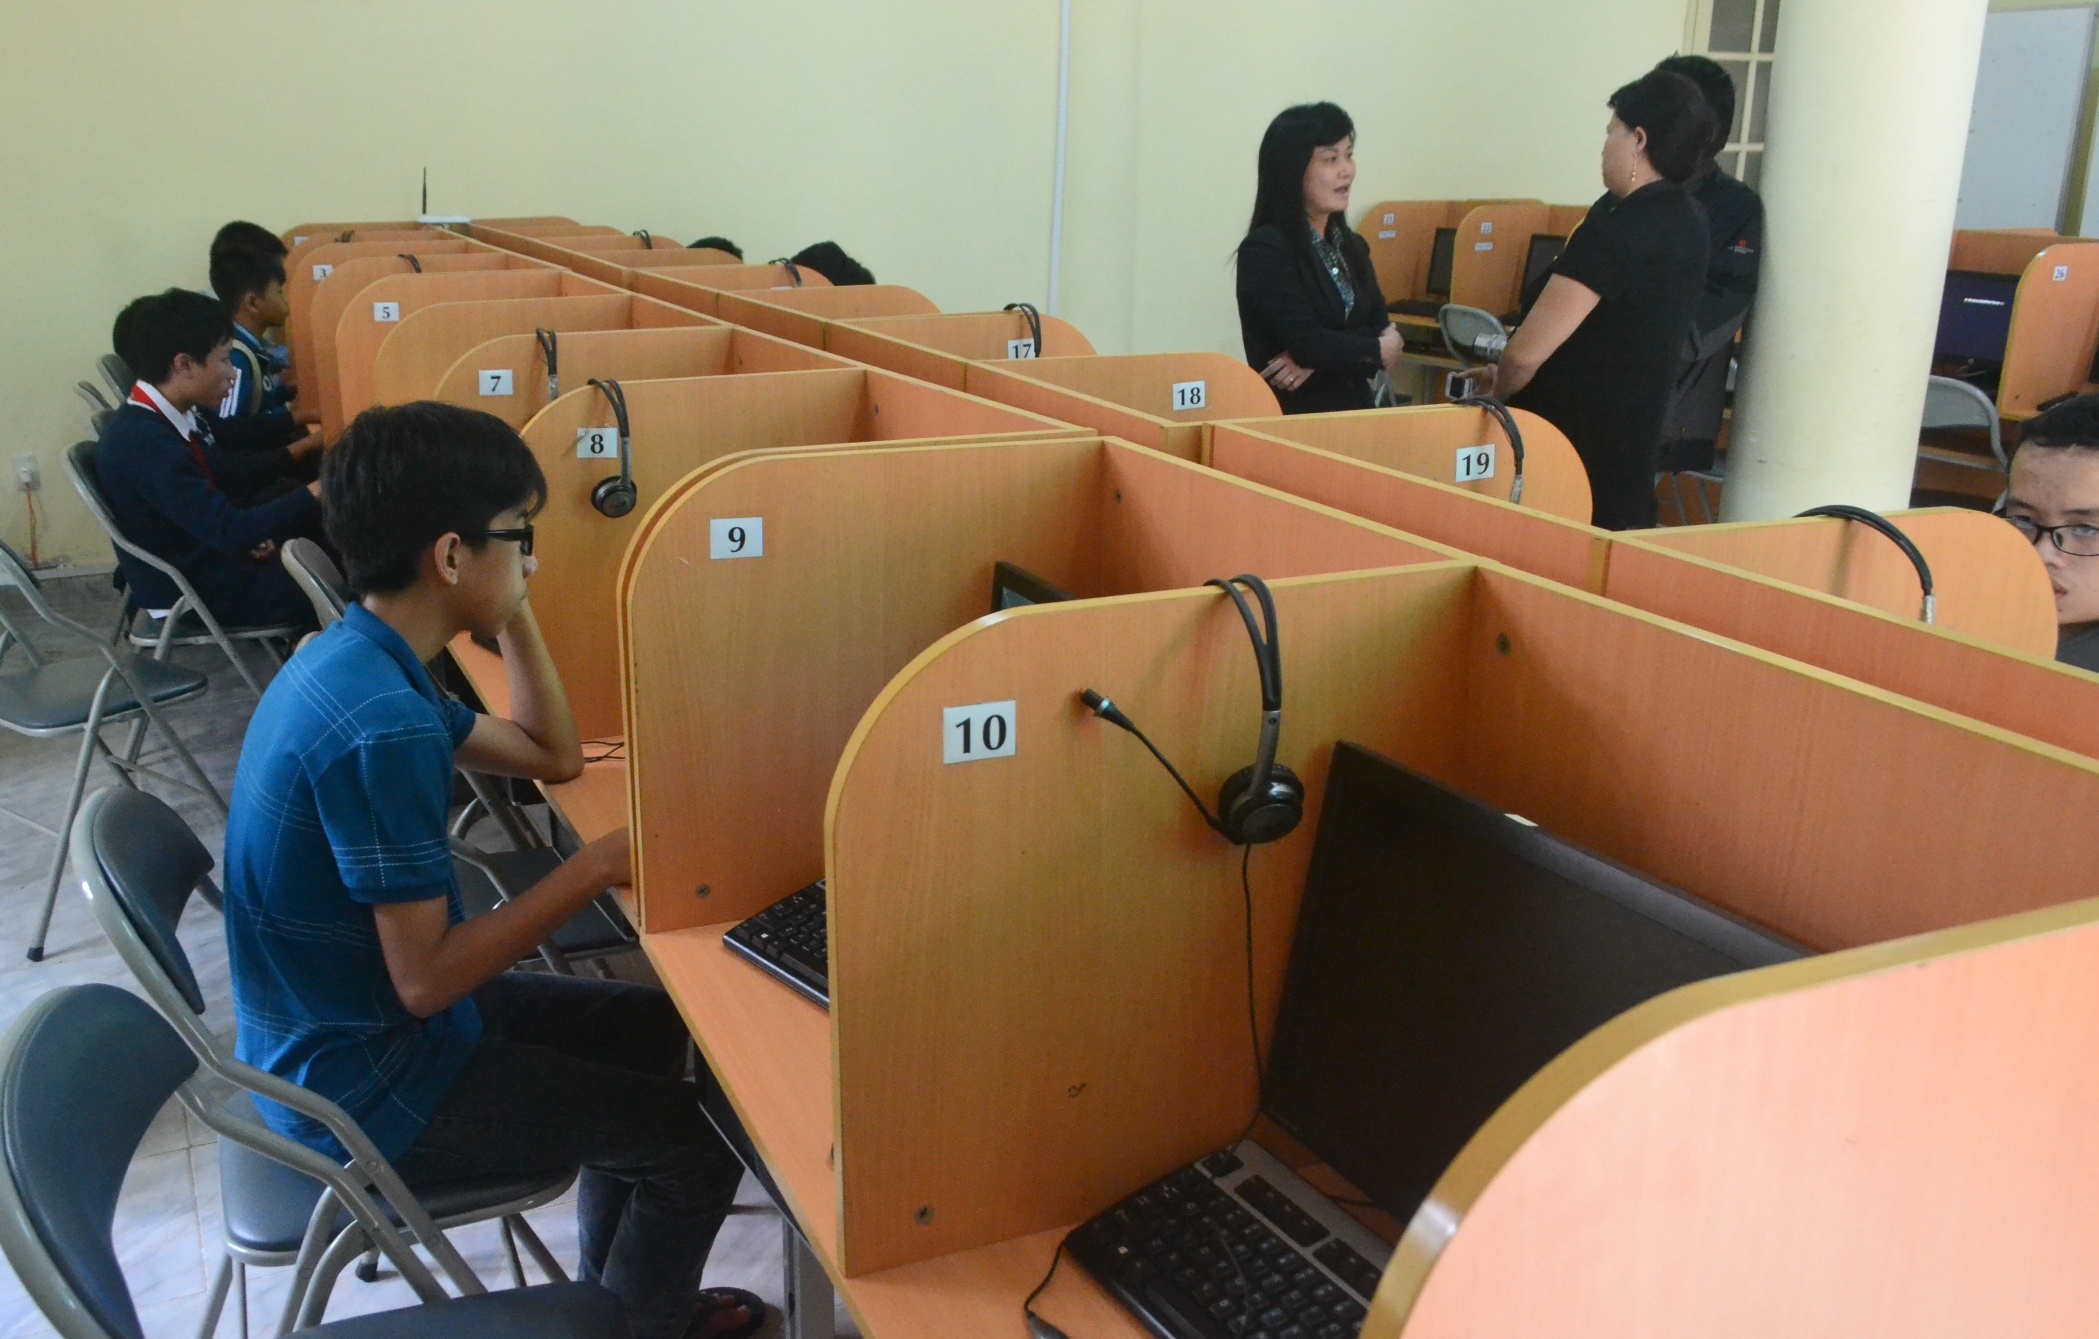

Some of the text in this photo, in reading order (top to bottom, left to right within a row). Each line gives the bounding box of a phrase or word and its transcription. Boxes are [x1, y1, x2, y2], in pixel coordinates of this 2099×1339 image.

[320, 268, 327, 278] 3
[382, 306, 391, 319] 5
[1012, 343, 1032, 358] 17
[490, 375, 502, 392] 7
[1177, 387, 1201, 406] 18
[590, 433, 604, 454] 8
[1462, 452, 1490, 476] 19
[728, 526, 746, 553] 9
[955, 714, 1007, 754] 10
